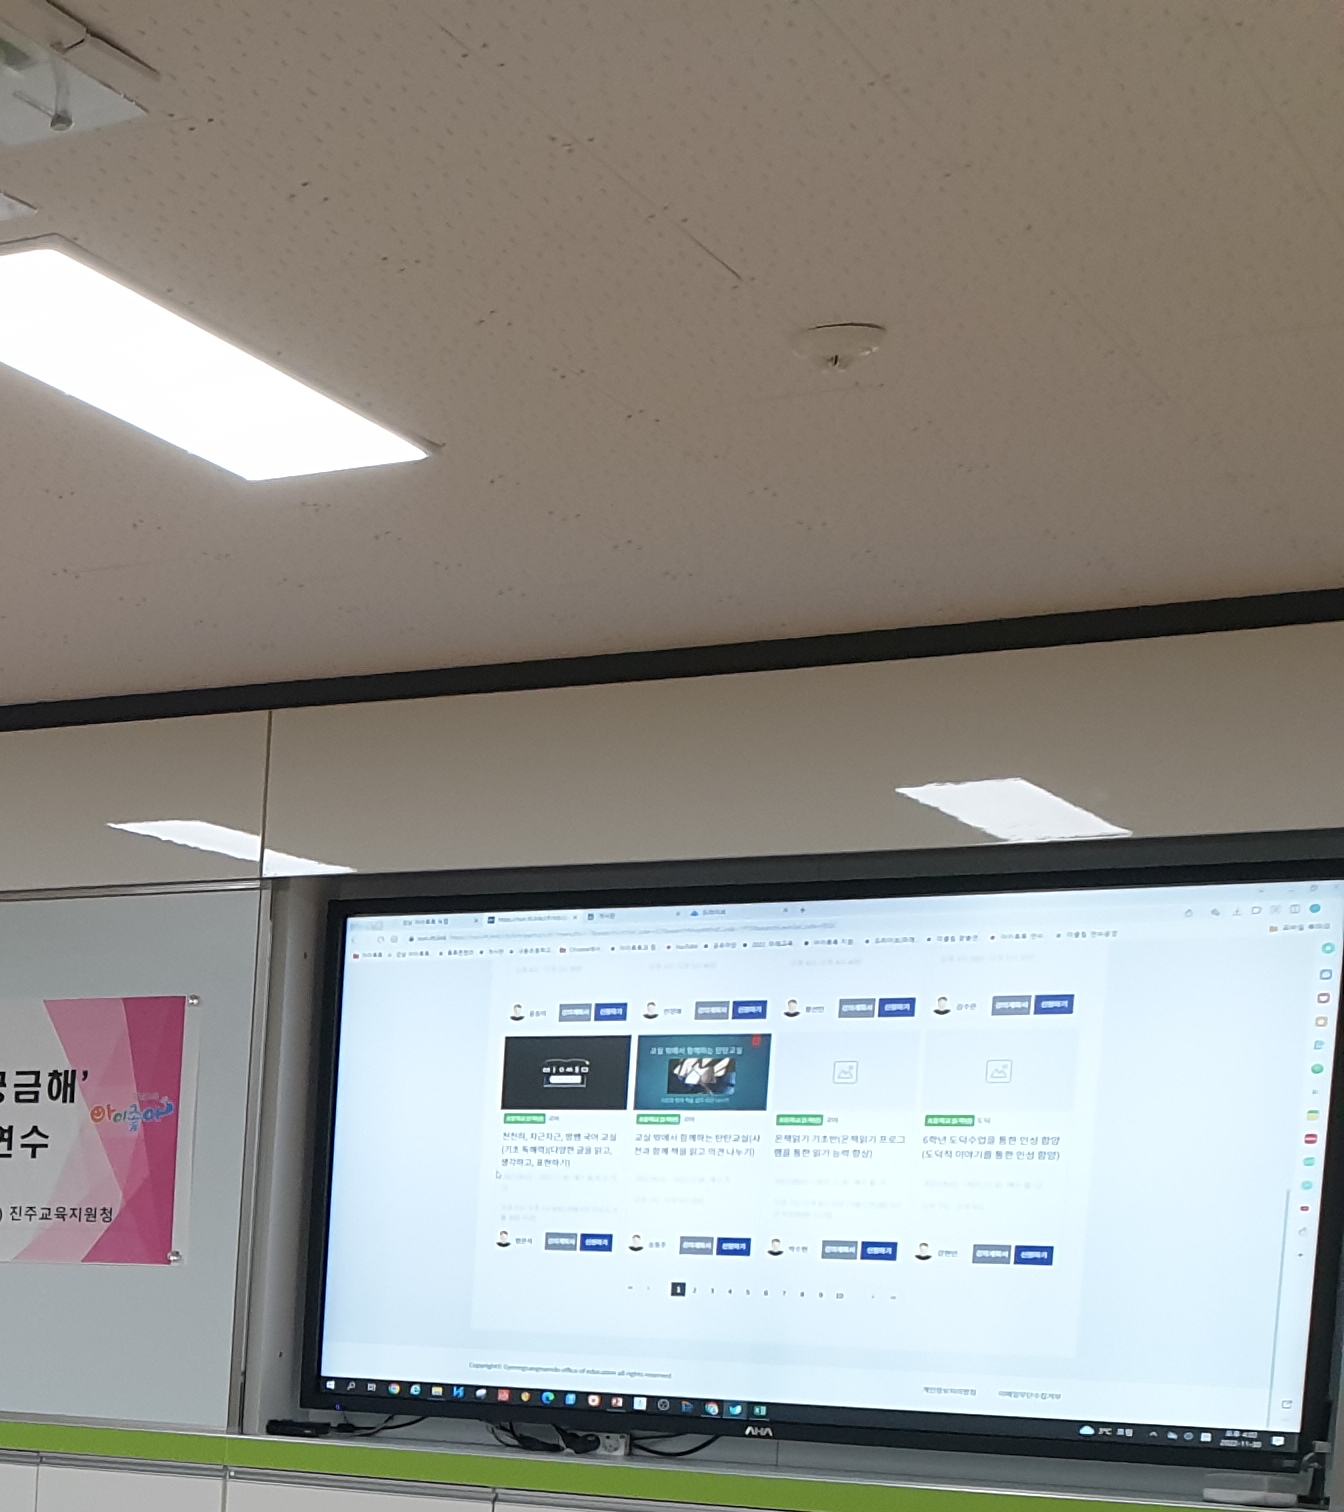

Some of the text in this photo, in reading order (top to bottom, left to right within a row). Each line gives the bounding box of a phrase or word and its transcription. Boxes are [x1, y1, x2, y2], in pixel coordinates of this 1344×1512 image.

[635, 1133, 651, 1141] 교실
[680, 1133, 713, 1142] 함께하는
[923, 1135, 946, 1144] 6학년
[999, 1136, 1017, 1145] 통한
[1019, 1136, 1038, 1145] 인성
[955, 1150, 992, 1159] 이야기를
[995, 1150, 1013, 1159] 통한
[1016, 1151, 1035, 1160] 인성
[9, 1206, 113, 1223] 진주교육지원청
